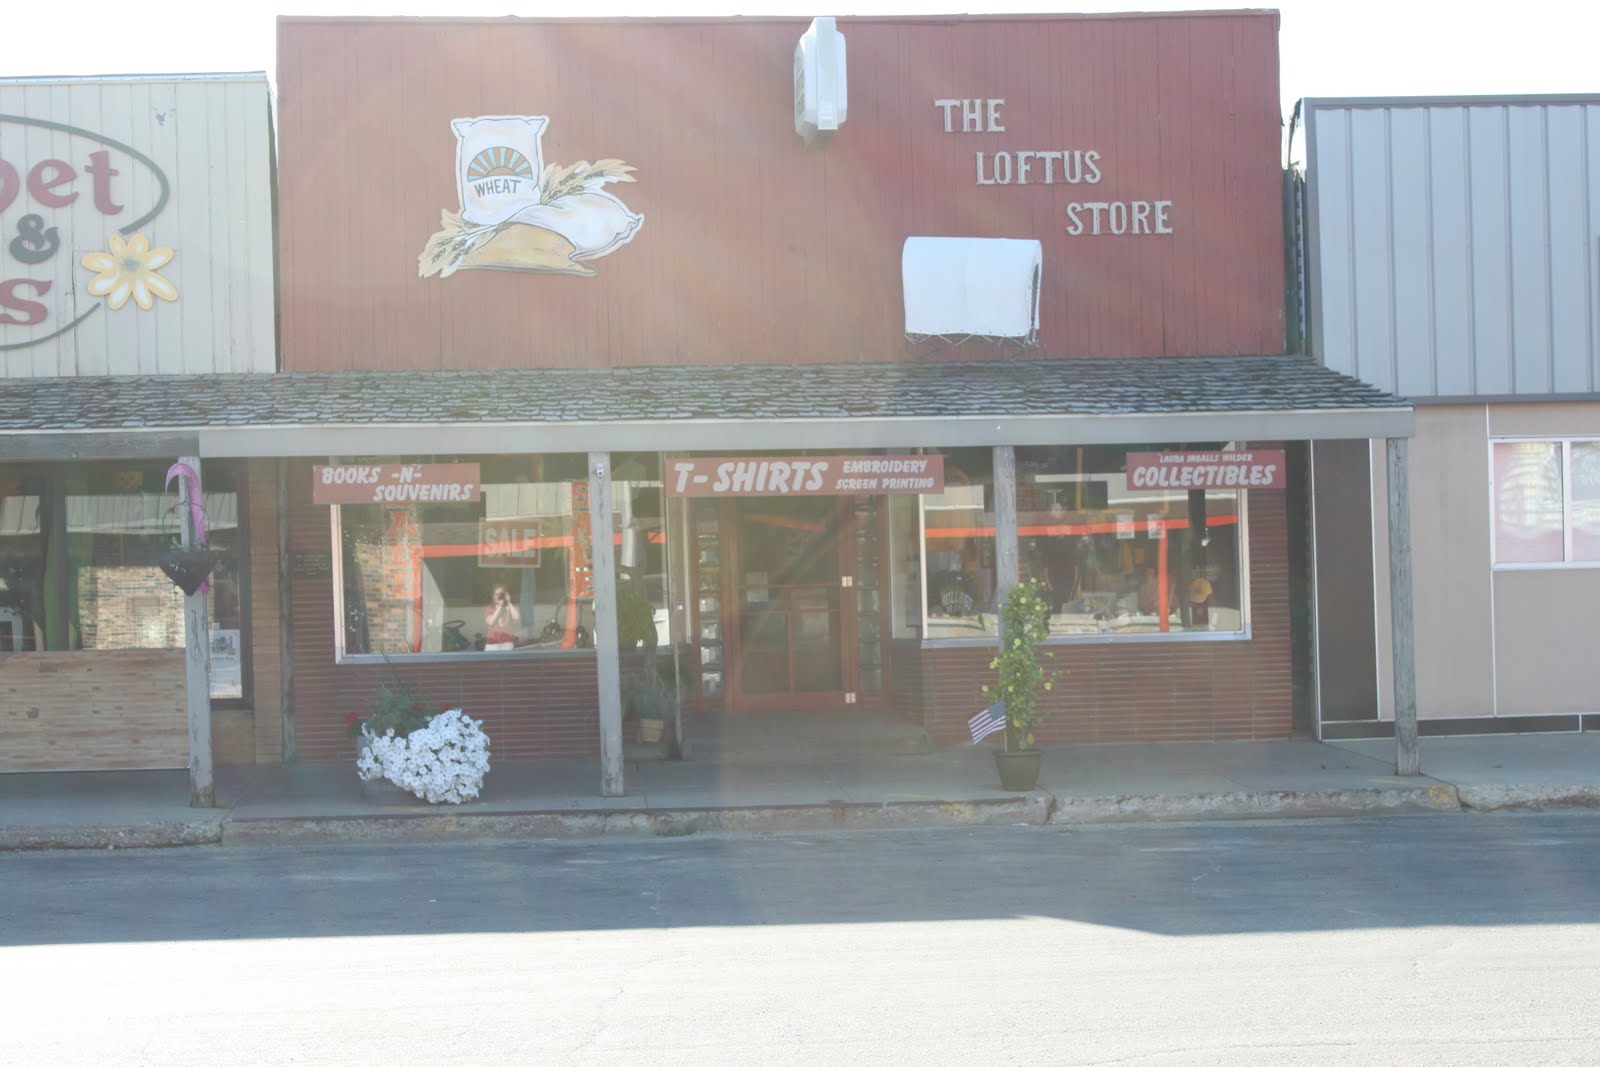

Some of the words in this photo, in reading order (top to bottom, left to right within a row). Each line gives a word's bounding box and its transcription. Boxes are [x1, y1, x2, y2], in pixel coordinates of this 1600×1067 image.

[935, 98, 1005, 132] THE
[975, 150, 1101, 185] LOFTUS
[474, 178, 522, 198] WHEAT
[1065, 201, 1173, 235] STORE
[843, 460, 928, 473] EMBROIDERY
[1160, 454, 1185, 463] LAURA
[1187, 453, 1219, 463] INGALLS
[1222, 453, 1253, 463] WILDER
[321, 466, 381, 484] BOOKS
[835, 478, 877, 489] SCREEN
[882, 477, 934, 489] PRINTING
[1133, 465, 1276, 487] COLLECTIBLES
[373, 483, 474, 501] SOUVENIRS
[485, 528, 536, 558] SALE
